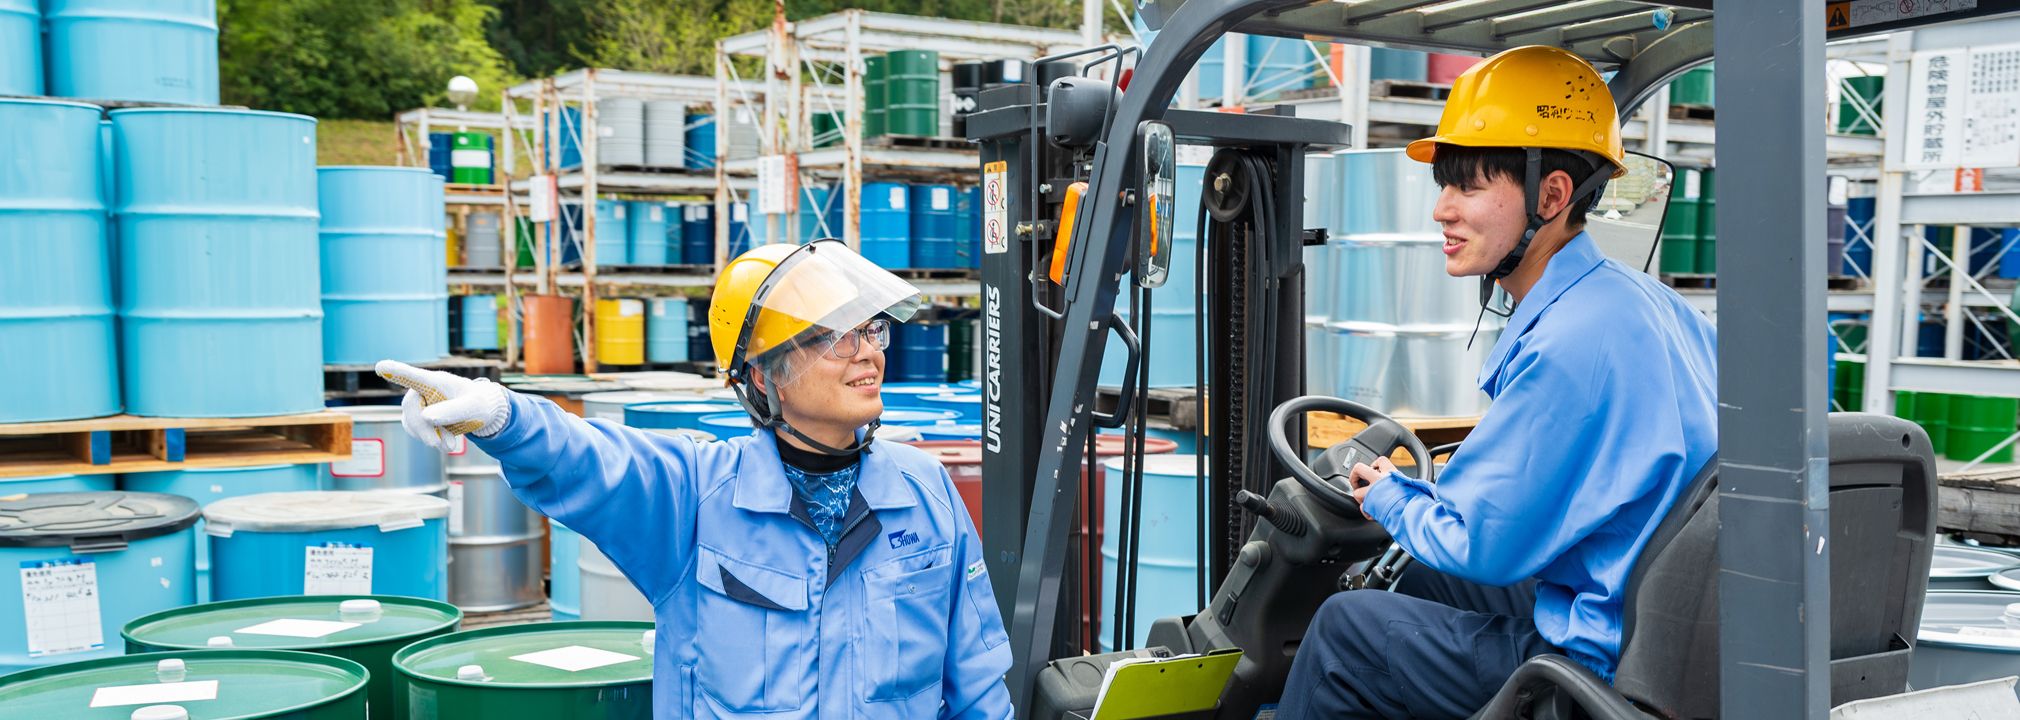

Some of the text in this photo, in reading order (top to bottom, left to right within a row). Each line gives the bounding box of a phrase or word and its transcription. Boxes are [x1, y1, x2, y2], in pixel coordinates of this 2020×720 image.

[1922, 56, 1949, 163] 危険物屋外貯蔵所
[986, 283, 1001, 454] UNICARRIERS
